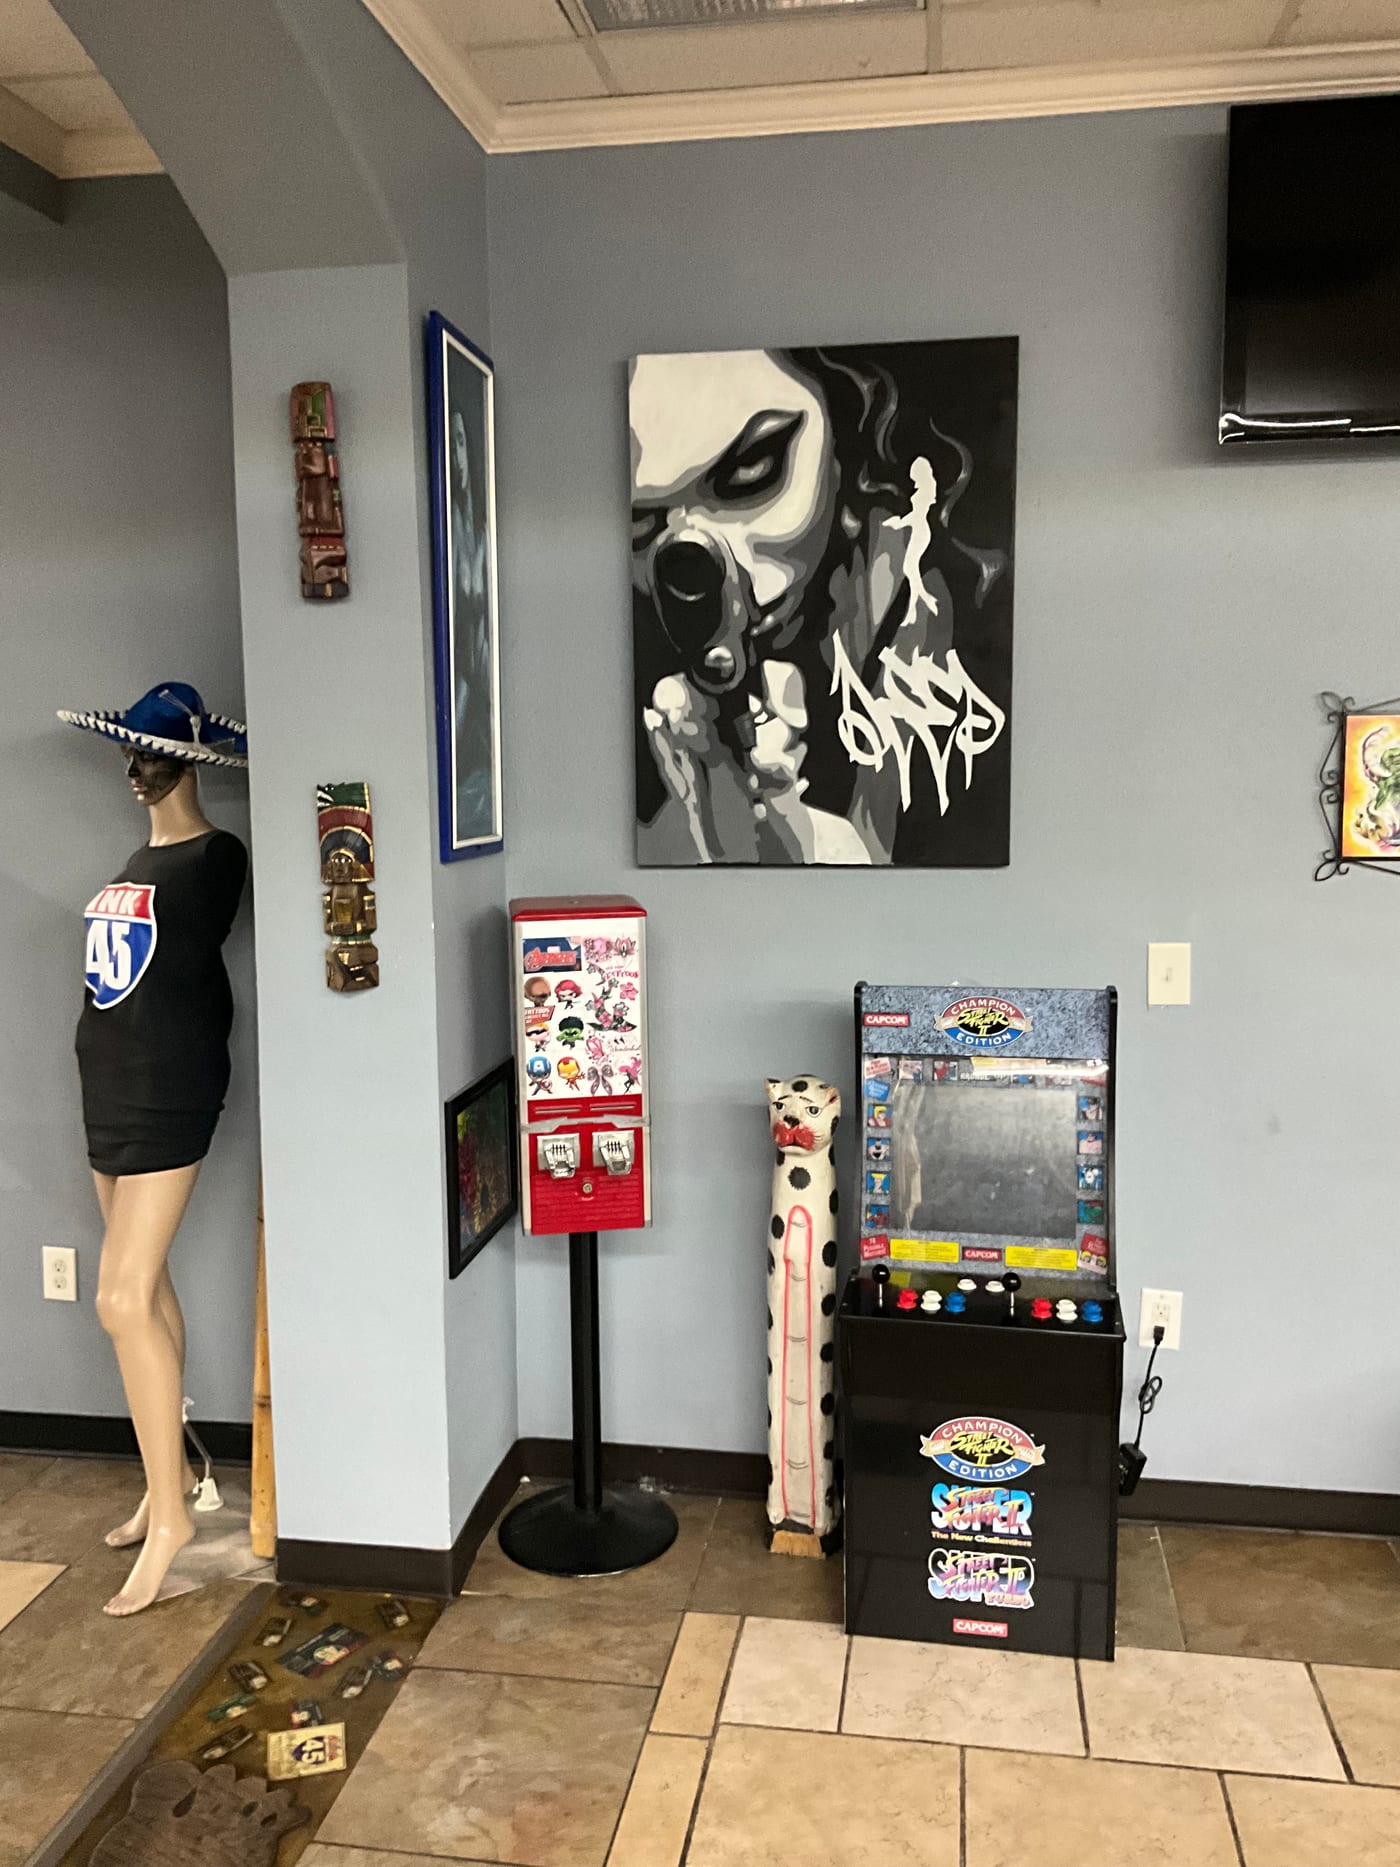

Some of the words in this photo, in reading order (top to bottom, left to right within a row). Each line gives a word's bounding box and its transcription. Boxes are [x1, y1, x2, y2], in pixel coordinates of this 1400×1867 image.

[86, 889, 143, 916] INK
[86, 919, 132, 991] 45
[951, 999, 1016, 1016] CHAMPION
[866, 1015, 906, 1025] CAPCOM
[956, 1033, 1012, 1046] EDITION
[965, 1249, 999, 1260] CAPCOM
[942, 1421, 1023, 1444] CHAMPION
[948, 1460, 1018, 1478] EDITION
[931, 1530, 949, 1539] The
[951, 1532, 974, 1542] New
[956, 1621, 1004, 1634] CAPCOM
[302, 1739, 324, 1765] 45
